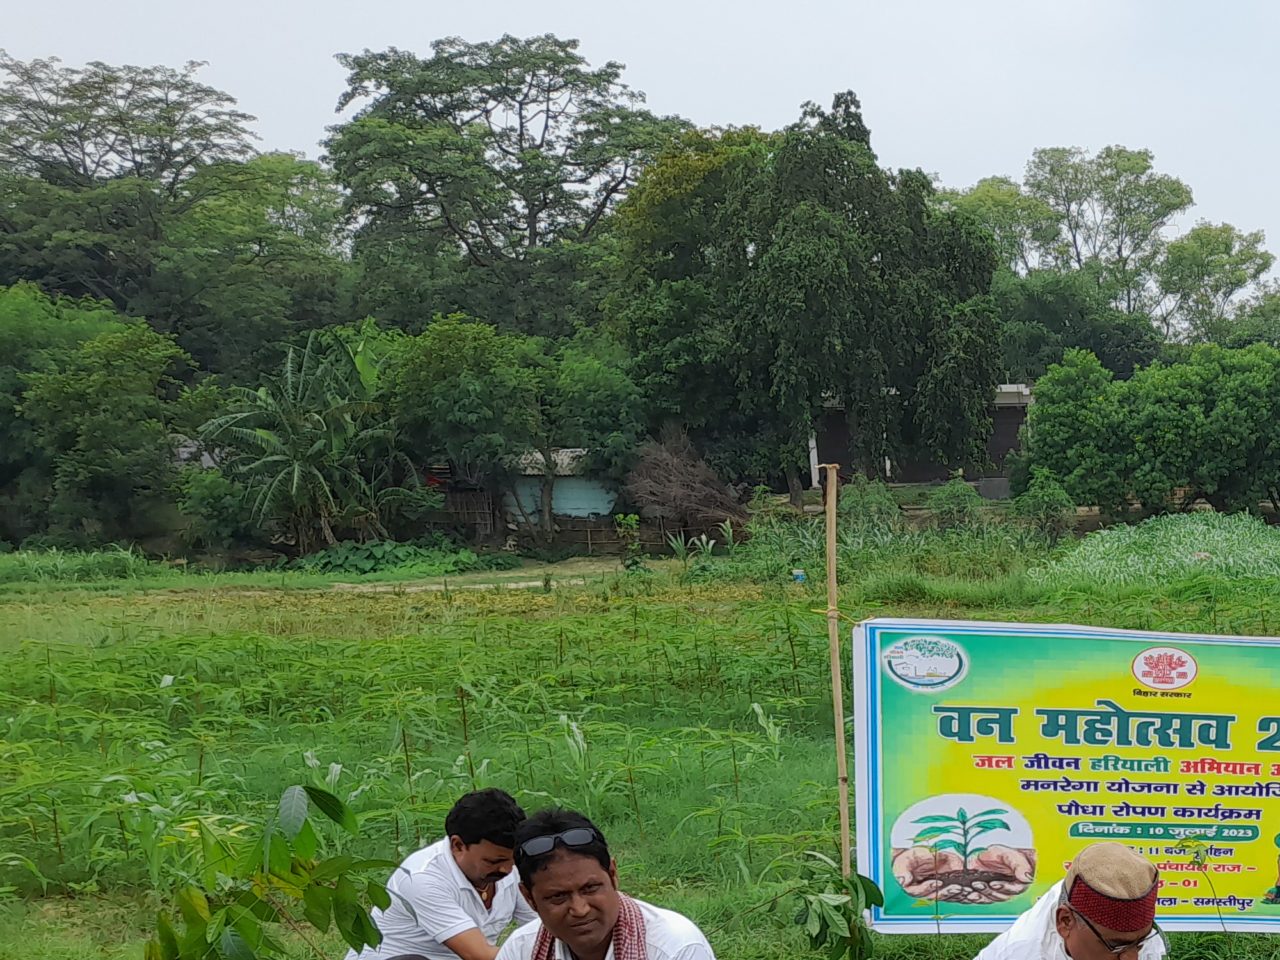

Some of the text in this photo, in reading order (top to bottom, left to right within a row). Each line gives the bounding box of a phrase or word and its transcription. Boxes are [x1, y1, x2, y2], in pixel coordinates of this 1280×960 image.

[1159, 691, 1193, 699] सरकार
[933, 705, 1019, 743] वन
[1036, 699, 1236, 750] महोत्सव
[973, 755, 1015, 769] जल
[1022, 753, 1081, 771] जीवन
[1089, 754, 1170, 773] हरियाली
[1180, 757, 1261, 777] अभियान
[1020, 776, 1099, 792] मनरेगा
[1105, 777, 1179, 794] योजना
[1185, 780, 1206, 795] से
[1057, 800, 1262, 821] पौधा रोपण कार्यक्रम
[1078, 822, 1131, 834] दिनांक
[1149, 827, 1164, 835] 10
[1168, 825, 1218, 839] जुलाई
[1222, 828, 1253, 837] 2023
[1214, 864, 1241, 872] राज
[1193, 895, 1254, 911] समस्तीपुर
